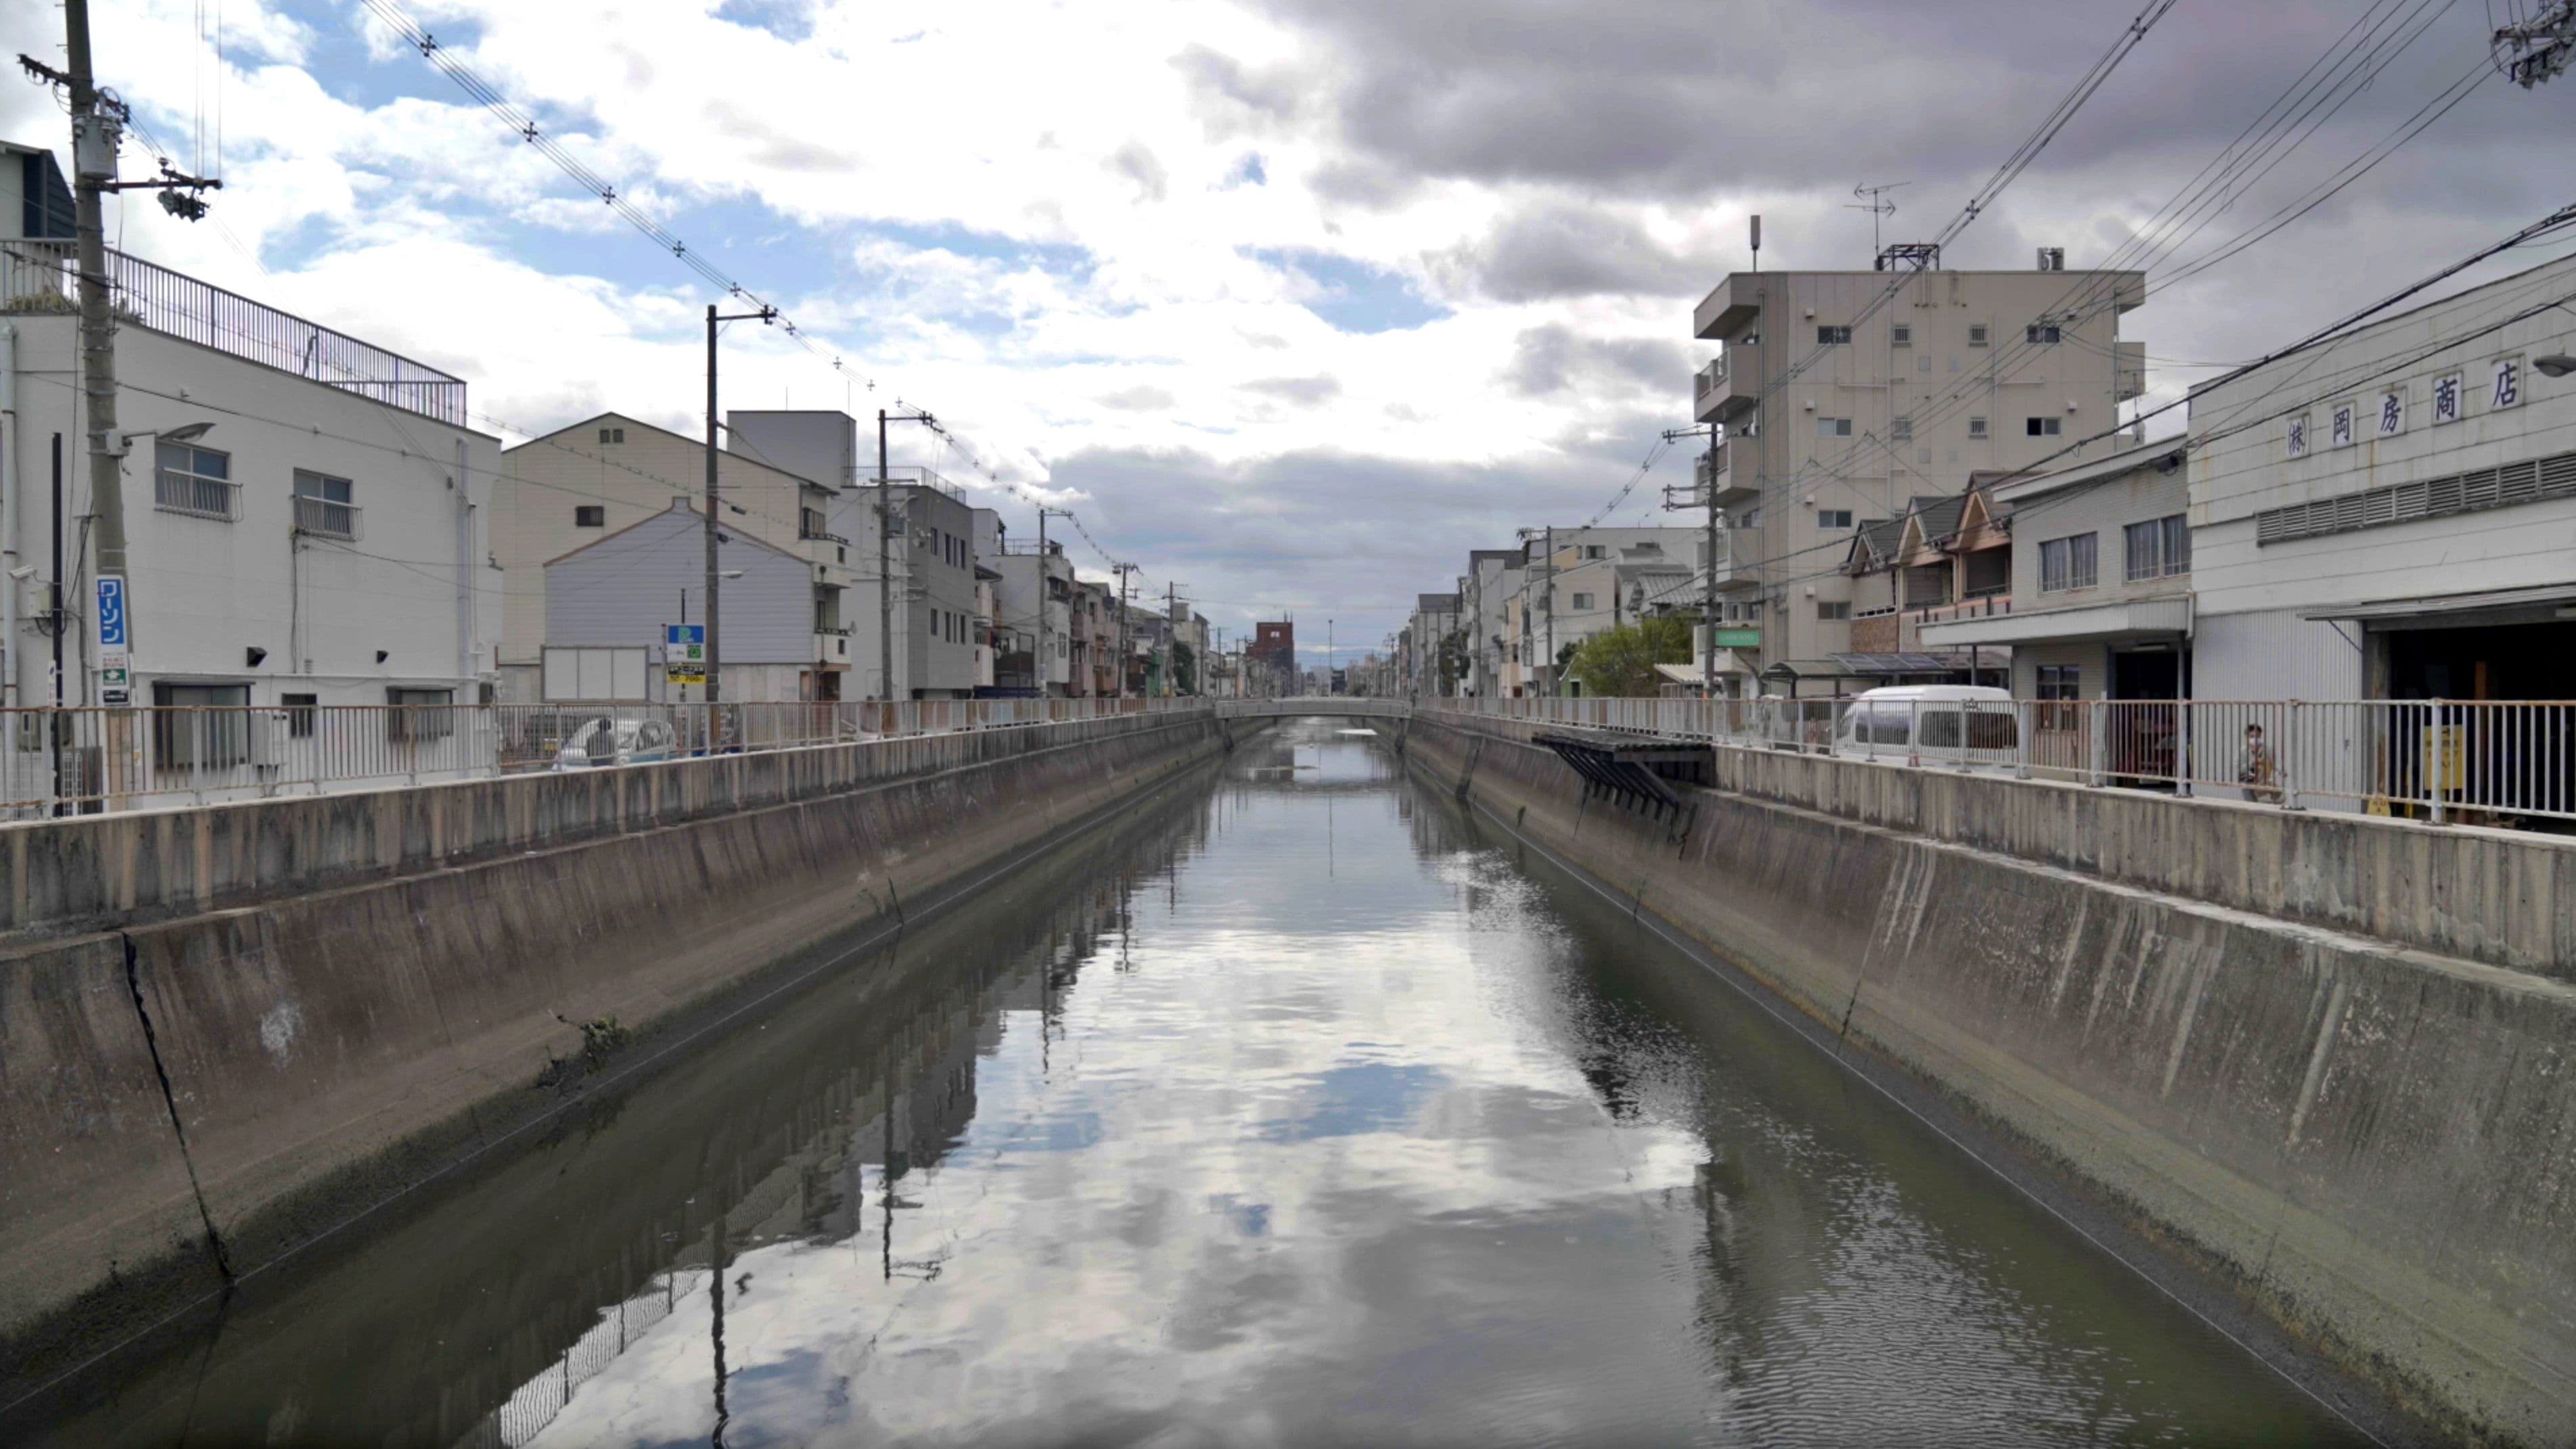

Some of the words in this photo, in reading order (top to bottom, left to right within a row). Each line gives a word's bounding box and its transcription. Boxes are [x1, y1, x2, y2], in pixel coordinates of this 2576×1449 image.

[100, 581, 120, 643] ローソン
[678, 626, 692, 643] P
